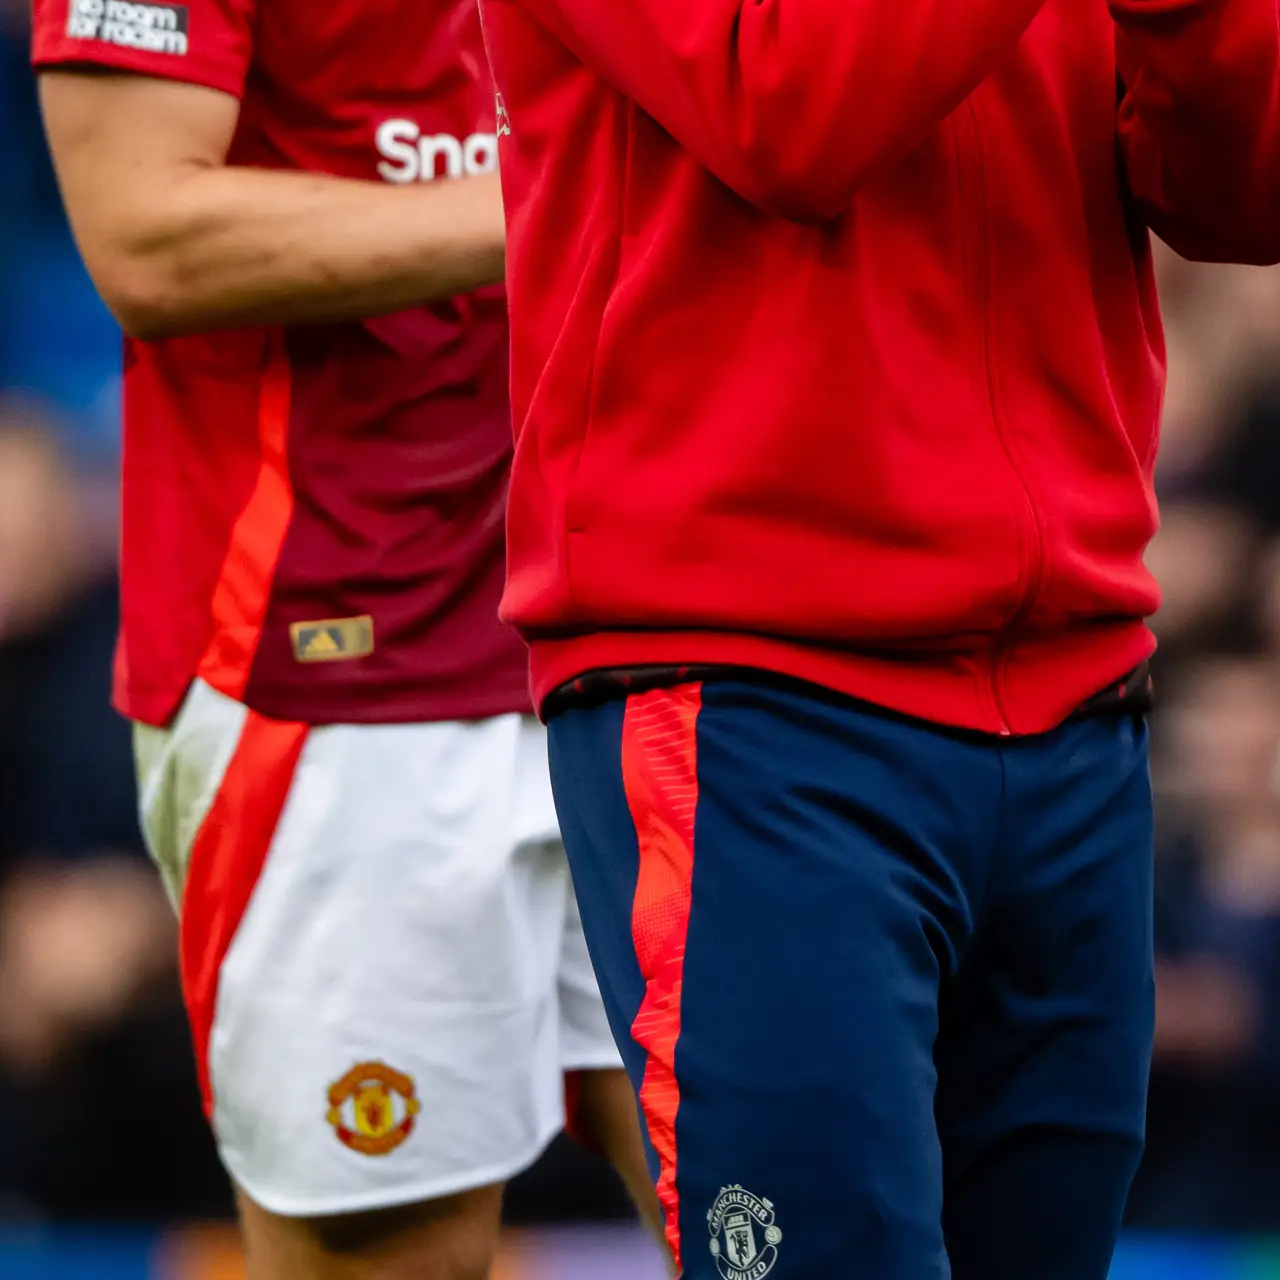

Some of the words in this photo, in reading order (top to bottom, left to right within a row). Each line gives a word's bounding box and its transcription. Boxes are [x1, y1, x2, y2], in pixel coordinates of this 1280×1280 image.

[375, 118, 499, 185] Sna
[712, 1192, 768, 1229] MANCHESTER
[727, 1261, 767, 1280] UNITED
